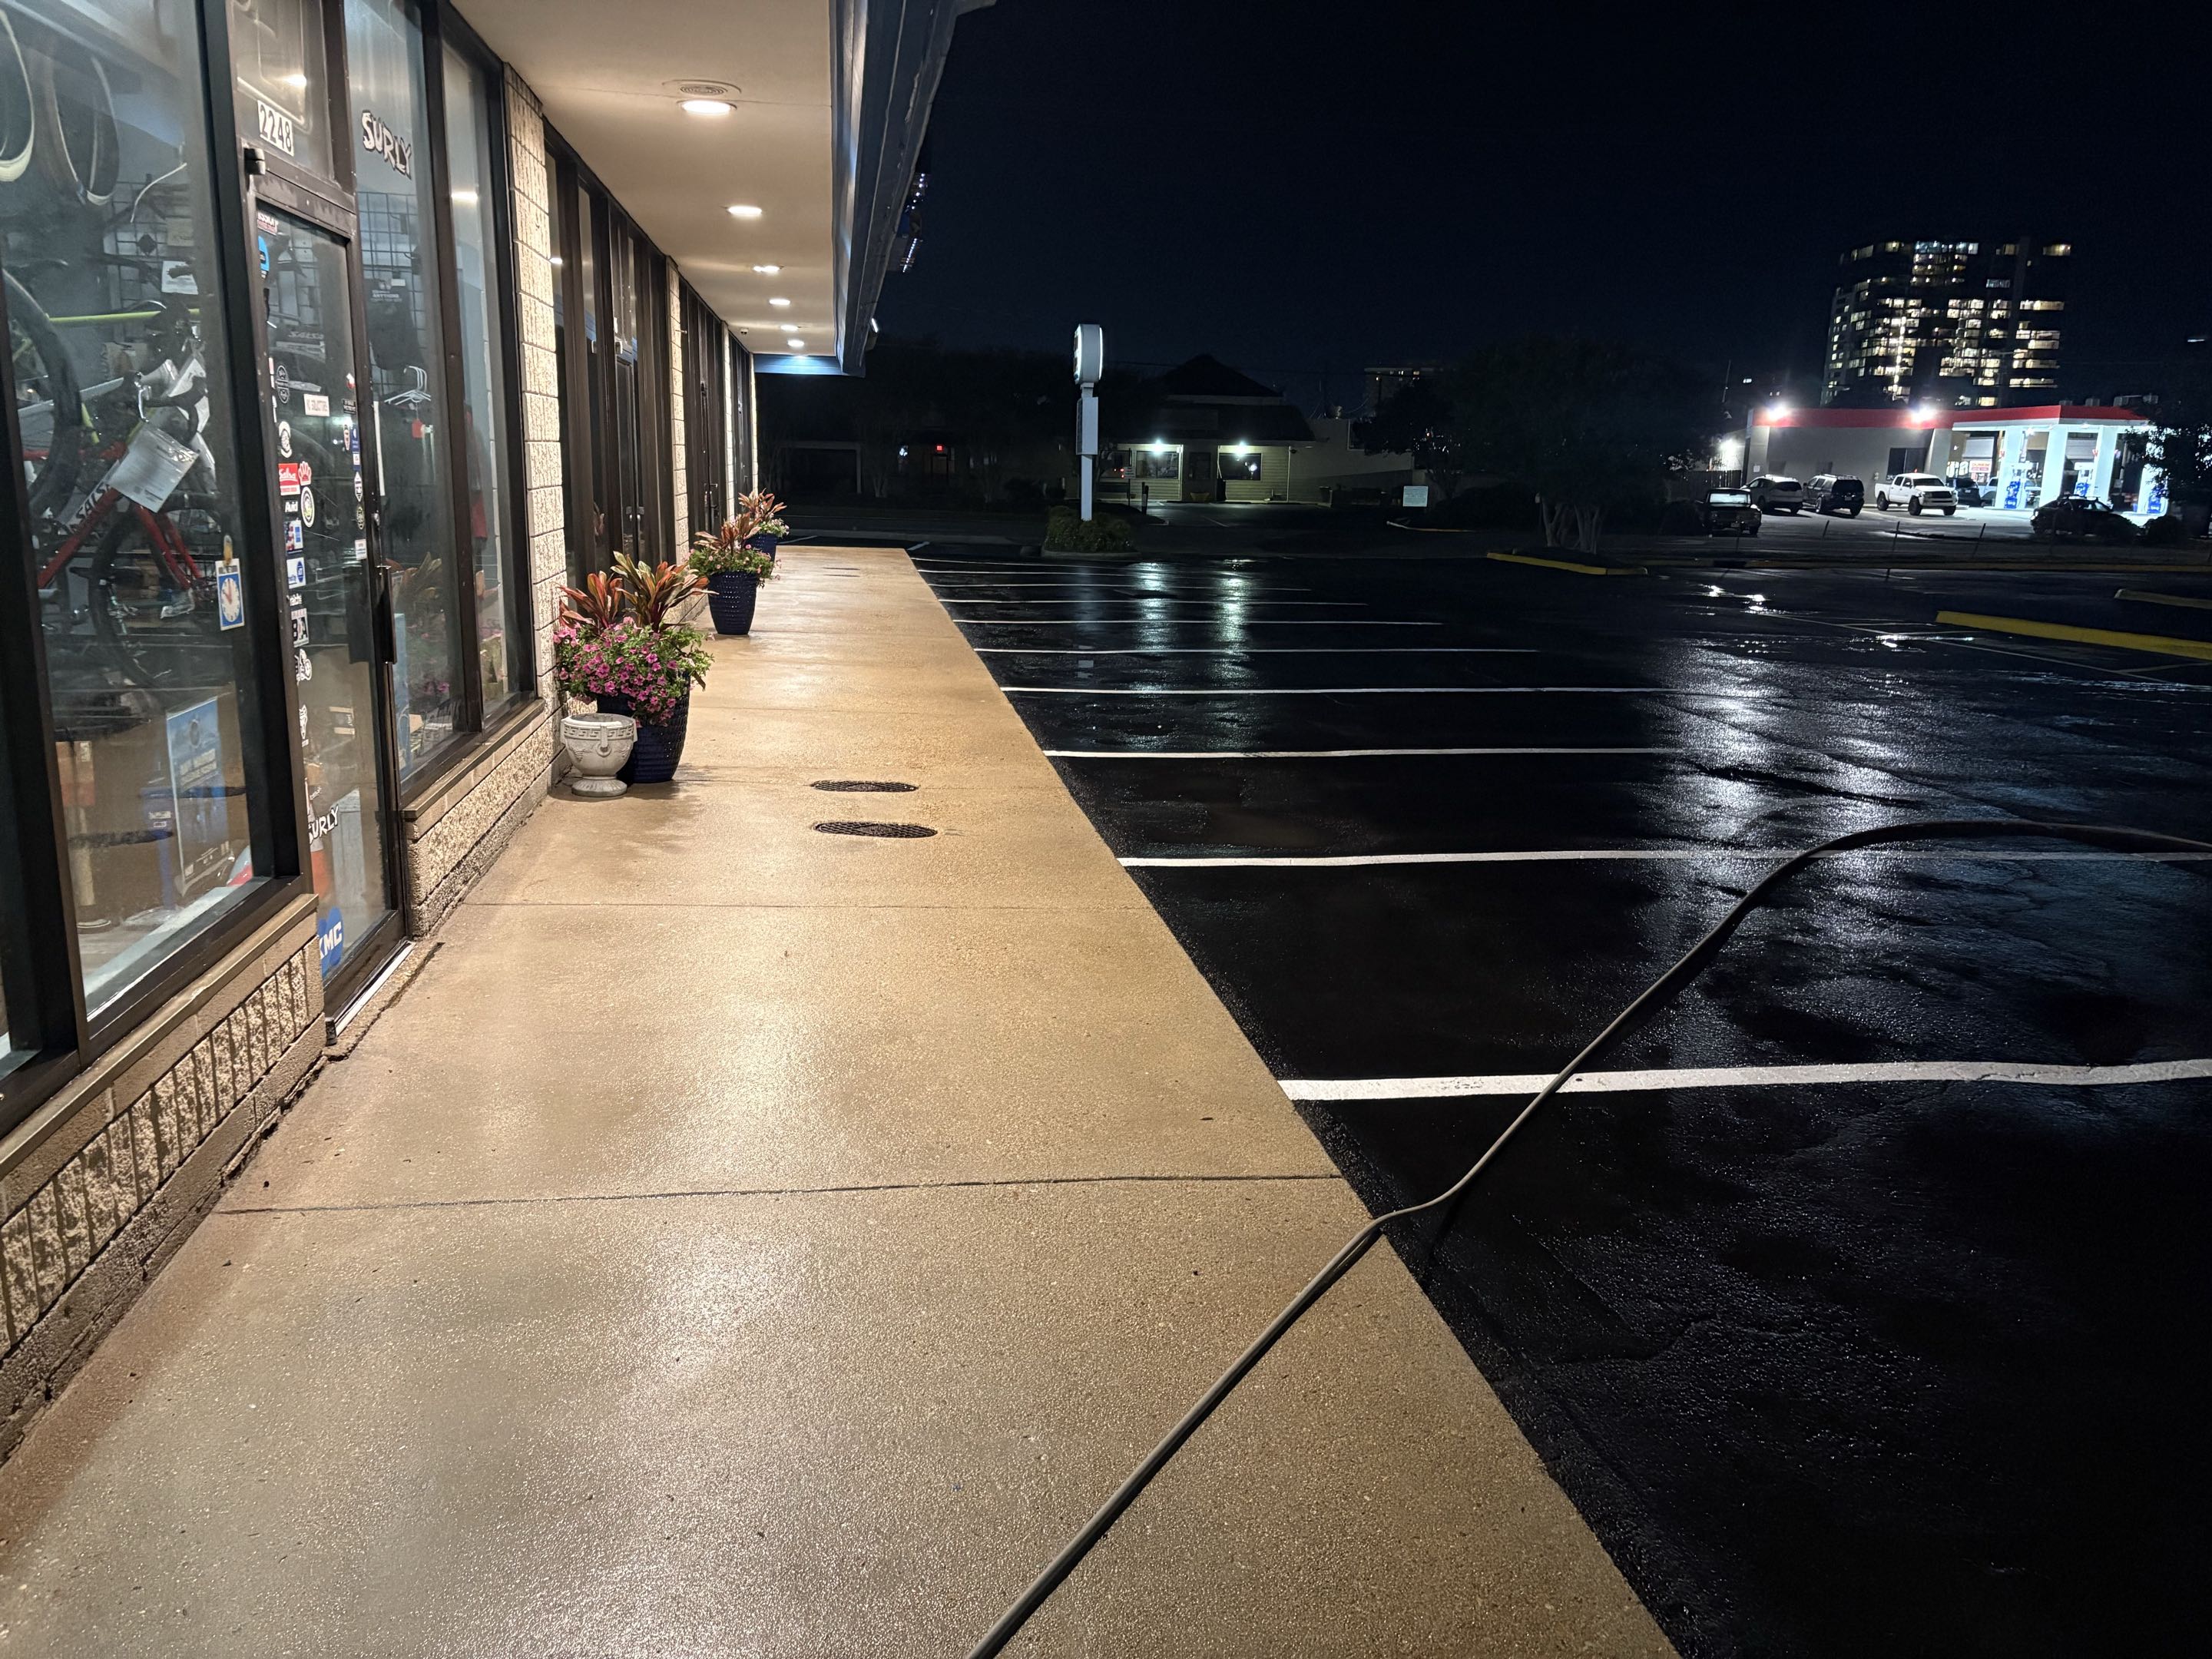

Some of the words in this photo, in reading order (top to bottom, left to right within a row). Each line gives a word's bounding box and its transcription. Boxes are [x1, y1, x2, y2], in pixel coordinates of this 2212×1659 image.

[260, 104, 292, 153] 2248
[362, 110, 412, 179] SURLY
[279, 467, 297, 480] Salsa
[75, 481, 111, 520] SALS
